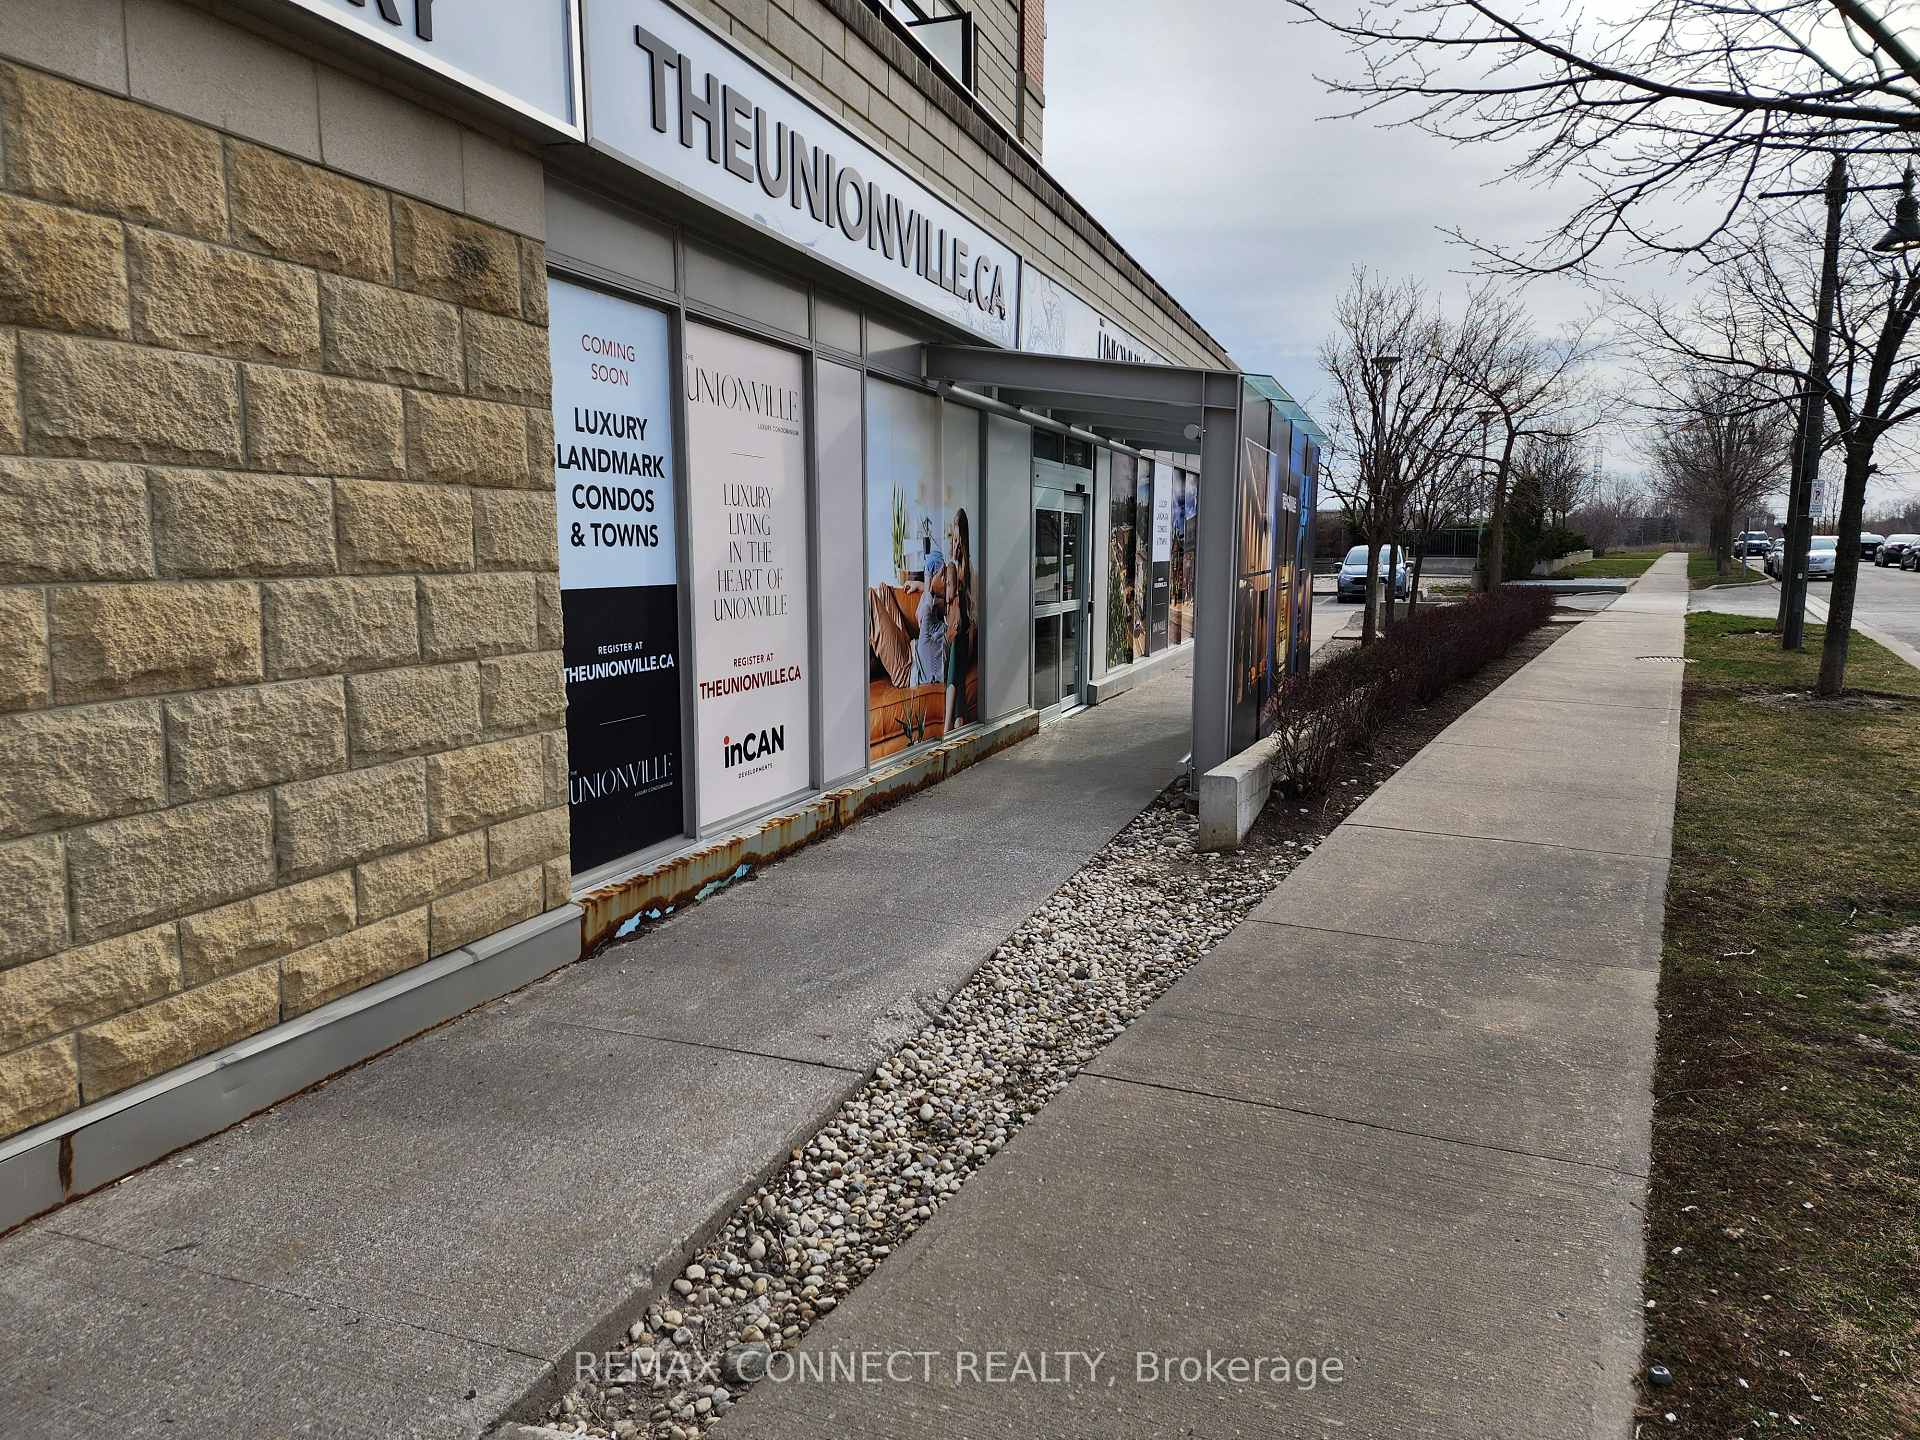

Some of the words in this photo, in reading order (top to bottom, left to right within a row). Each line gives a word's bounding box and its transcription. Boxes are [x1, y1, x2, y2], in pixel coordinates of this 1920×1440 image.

[634, 24, 1006, 321] THEUNIONVILLE.CA
[581, 334, 636, 362] COMING
[591, 363, 629, 387] SOON
[686, 365, 800, 423] UNIONVILLE
[574, 407, 648, 441] LUXURY
[557, 443, 665, 479] LANDMARK
[572, 483, 655, 512] CONDOS
[723, 482, 773, 508] LUXURY
[570, 521, 586, 548] &
[590, 522, 659, 548] TOWNS
[729, 512, 771, 536] LIVING
[729, 541, 742, 563] IN
[747, 541, 773, 563] THE
[717, 568, 763, 593] HEART
[767, 567, 783, 590] OF
[713, 594, 788, 622] UNIONVILLE
[597, 643, 633, 655] REGISTER
[634, 641, 644, 651] AT
[734, 655, 765, 668] REGISTER
[766, 652, 775, 663] AT
[563, 653, 675, 684] THEUNIONVILLE.CA
[699, 665, 802, 700] THEUNIONVILLE.CA
[723, 724, 785, 769] inCAN
[570, 752, 673, 805] UNIONVILLE
